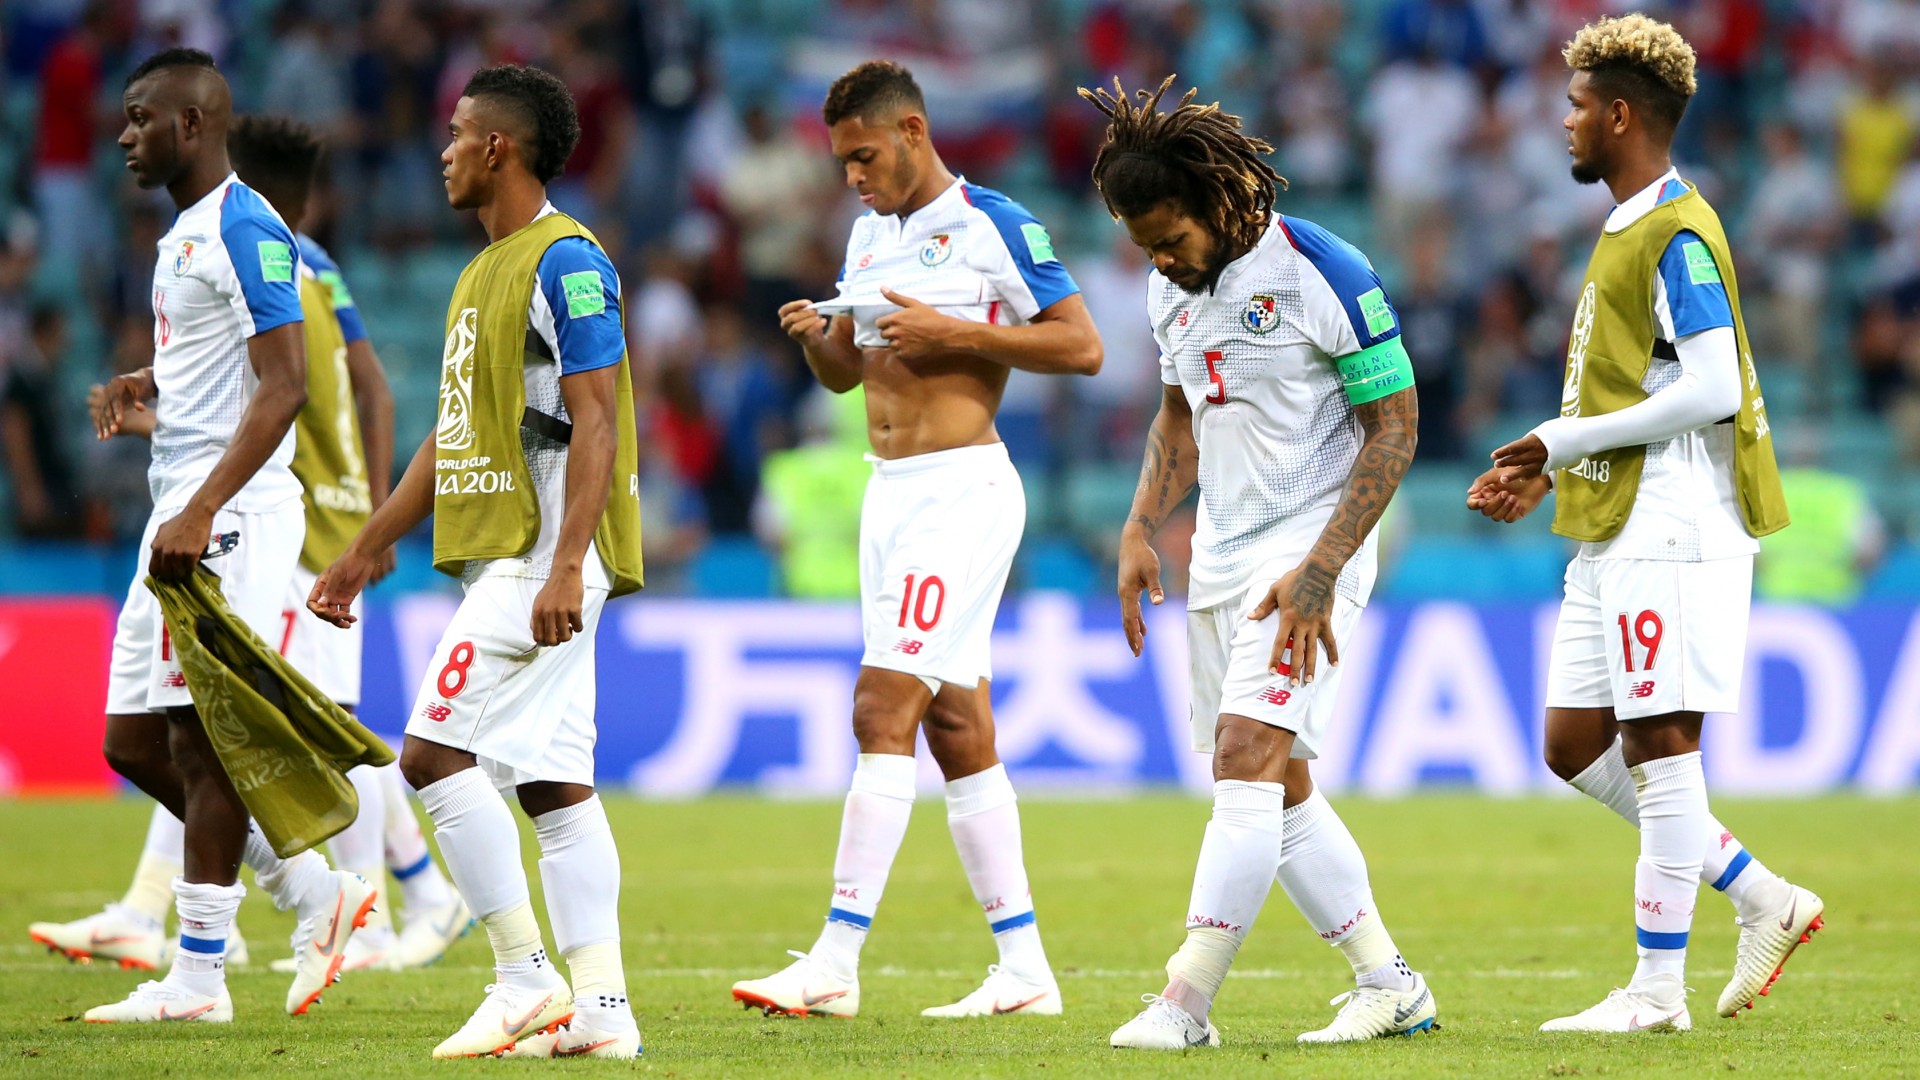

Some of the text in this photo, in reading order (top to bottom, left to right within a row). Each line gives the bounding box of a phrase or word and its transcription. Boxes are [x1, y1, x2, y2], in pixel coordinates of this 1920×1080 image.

[1203, 350, 1227, 405] 5
[1374, 374, 1402, 390] FIFA
[469, 456, 491, 467] CUP
[897, 573, 946, 632] 10
[1617, 609, 1666, 673] 19
[437, 641, 477, 700] 8
